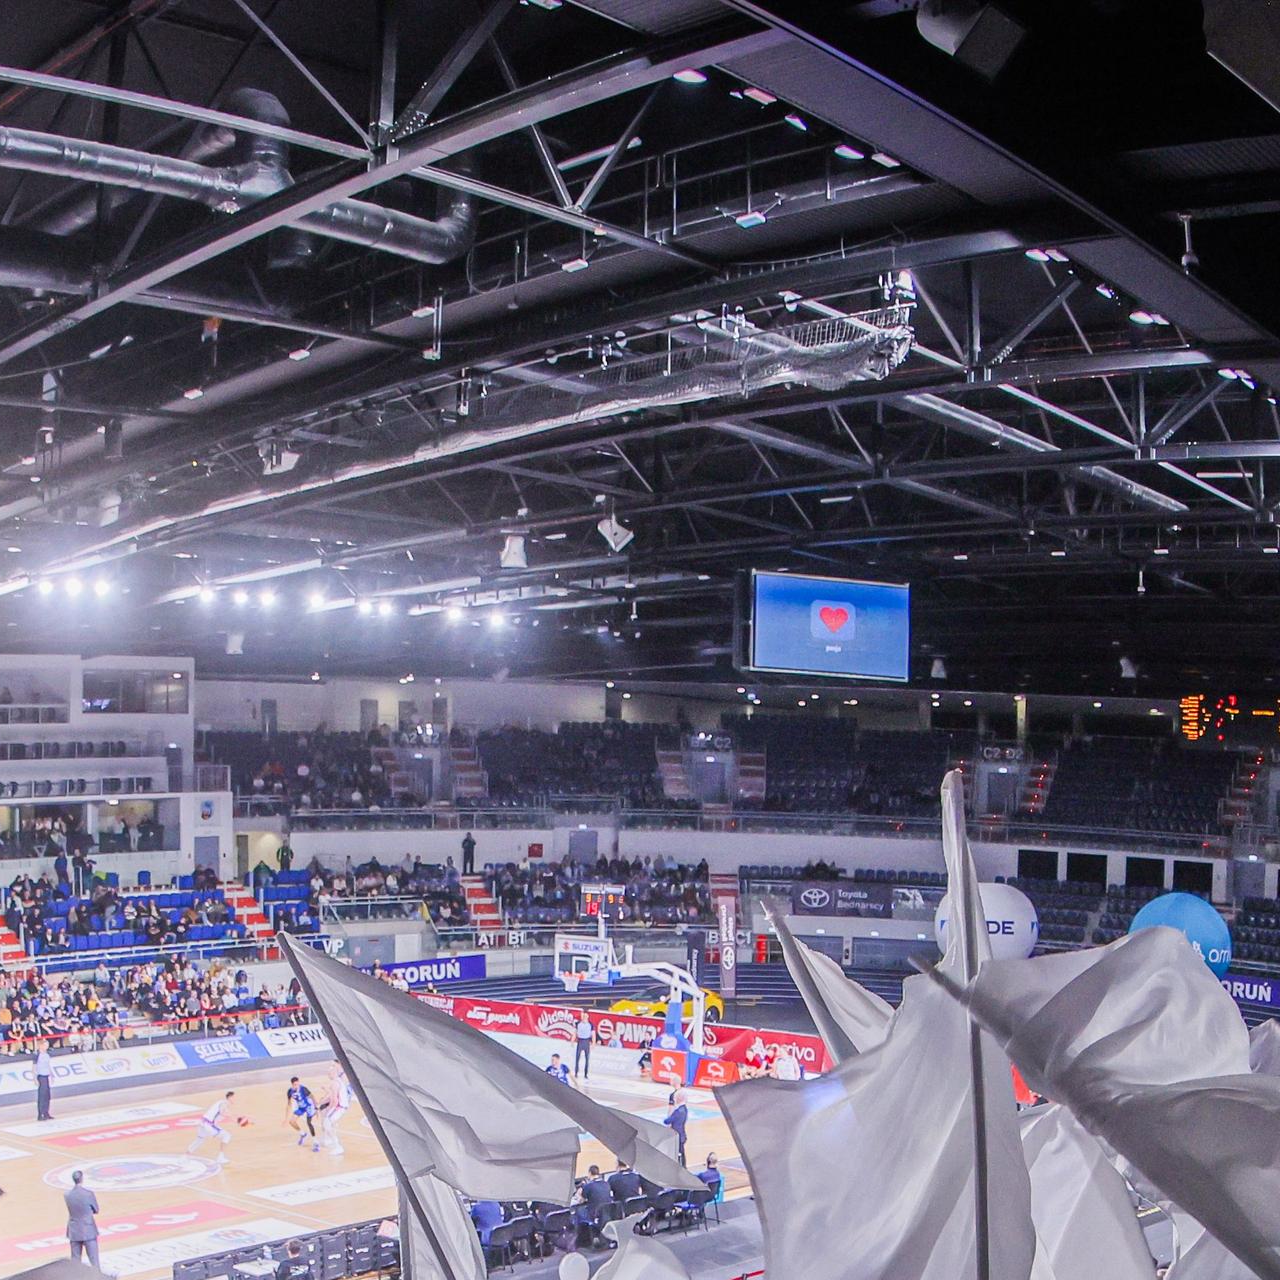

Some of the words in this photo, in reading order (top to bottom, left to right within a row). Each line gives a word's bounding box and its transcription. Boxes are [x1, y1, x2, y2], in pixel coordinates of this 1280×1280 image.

[837, 889, 868, 901] Toyota
[322, 937, 345, 954] VIP
[572, 943, 605, 953] SUZUKI
[395, 959, 461, 985] TORUŃ
[1221, 980, 1272, 1003] ORUŃ
[195, 1040, 249, 1058] SELENKA
